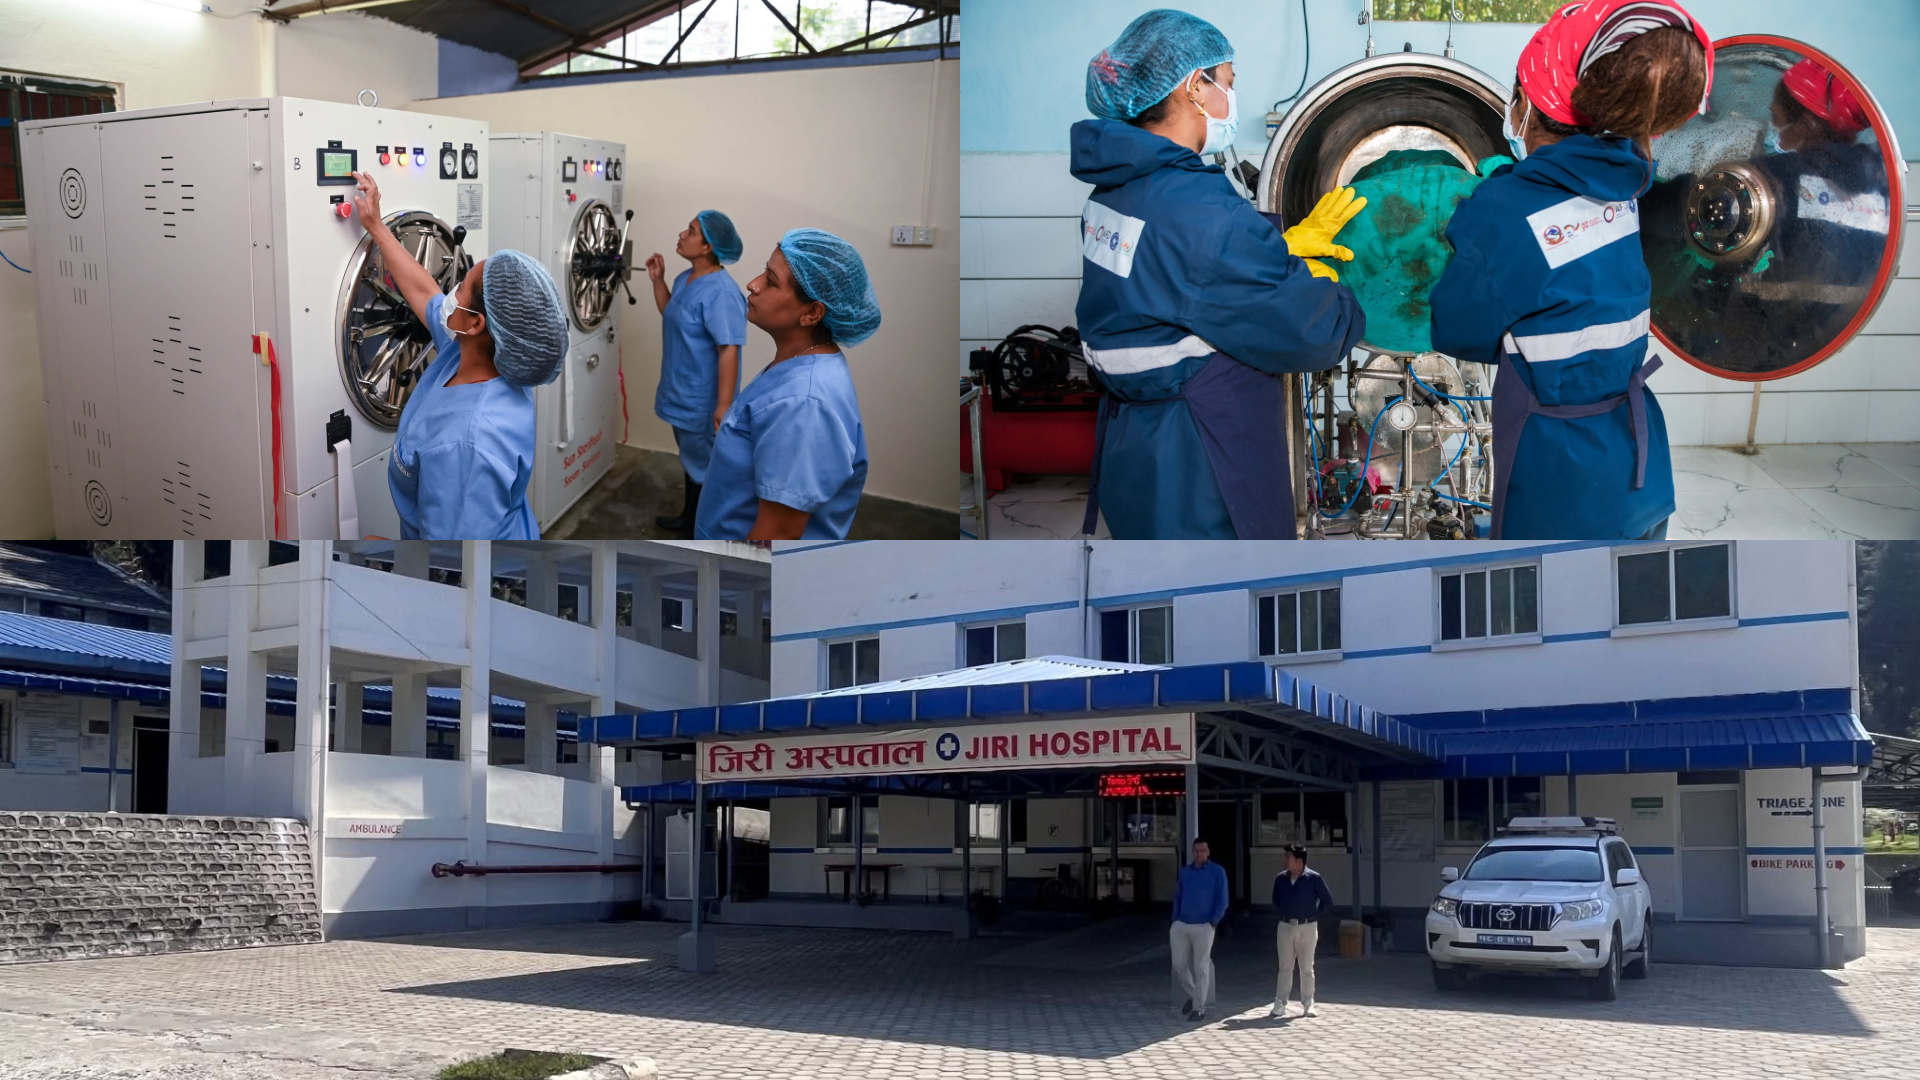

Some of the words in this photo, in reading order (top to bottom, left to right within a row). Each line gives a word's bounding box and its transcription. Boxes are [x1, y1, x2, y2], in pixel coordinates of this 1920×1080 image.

[294, 157, 301, 171] B
[965, 735, 1018, 760] JIRI
[1029, 727, 1182, 757] HOSPITAL
[709, 743, 775, 773] जिरी
[785, 740, 928, 770] अस्पताल
[1757, 798, 1806, 808] TRIAGE
[349, 824, 402, 834] AMBULANCE
[1759, 859, 1782, 869] BIKE
[1786, 859, 1834, 869] PARKG
